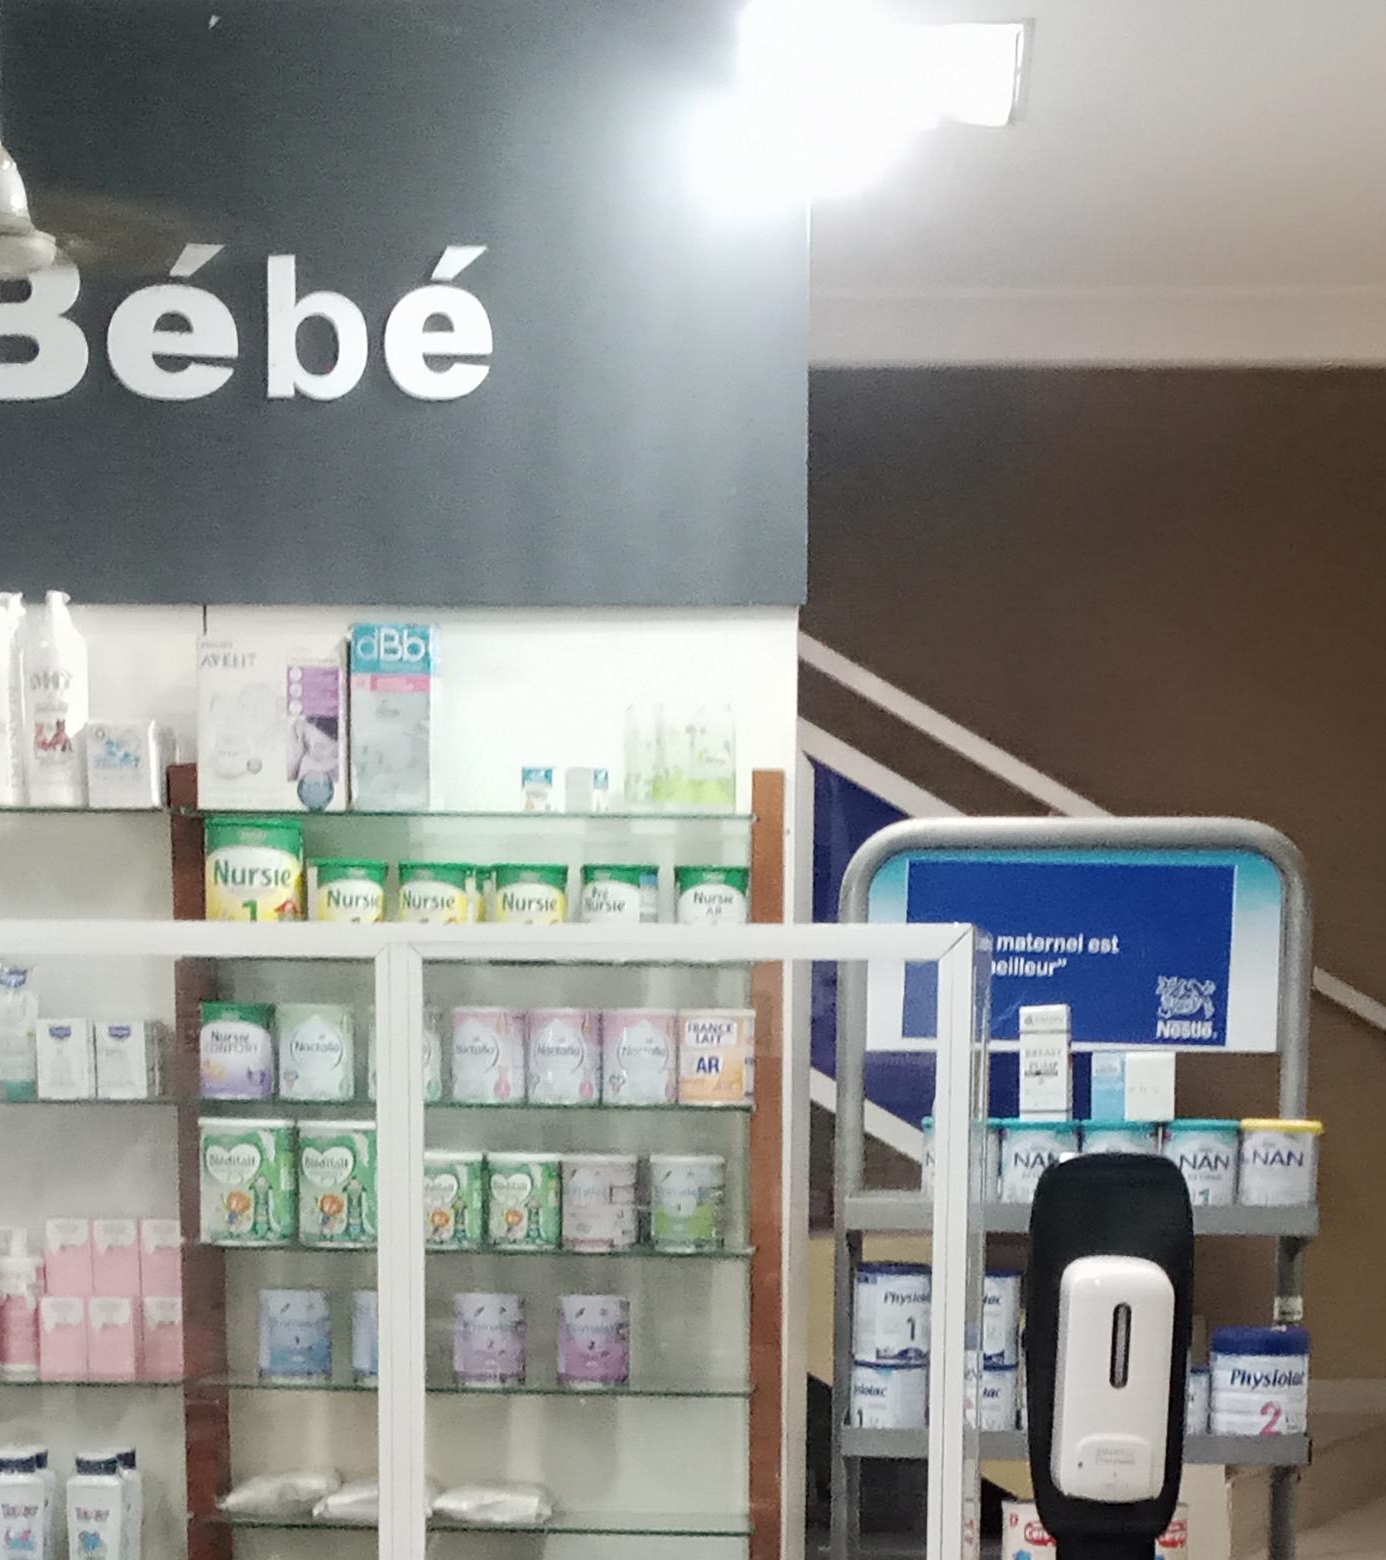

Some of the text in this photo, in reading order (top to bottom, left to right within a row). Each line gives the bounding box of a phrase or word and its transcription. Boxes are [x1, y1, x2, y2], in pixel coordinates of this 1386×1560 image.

[213, 859, 292, 887] Nursie
[326, 888, 381, 909] Nursie
[400, 890, 456, 911] Nursie
[502, 893, 558, 913] Nursie
[693, 891, 734, 905] Nursie
[996, 933, 1120, 954] maternel est
[696, 1056, 721, 1074] AR
[1179, 1154, 1230, 1170] NAN
[1252, 1149, 1305, 1168] NAN
[1259, 1400, 1282, 1435] 2
